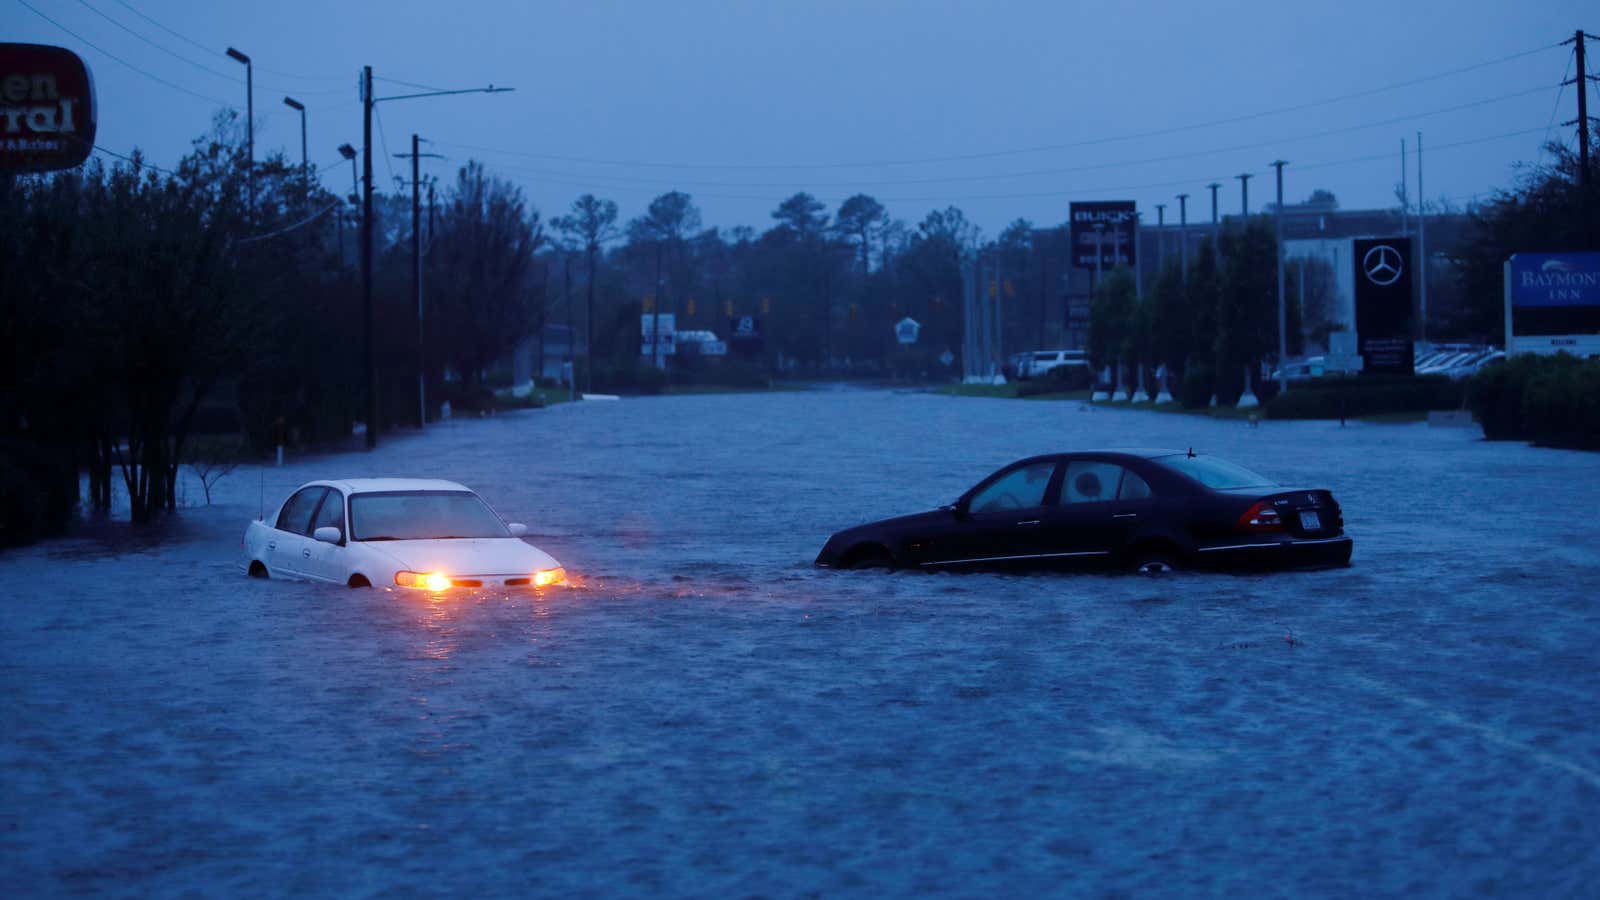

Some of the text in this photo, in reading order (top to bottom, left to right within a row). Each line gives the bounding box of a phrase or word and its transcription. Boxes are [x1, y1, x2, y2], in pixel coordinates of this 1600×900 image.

[0, 95, 75, 133] ral
[1074, 210, 1131, 222] BUICK
[1520, 271, 1600, 287] BAYMON
[1549, 288, 1581, 300] INN
